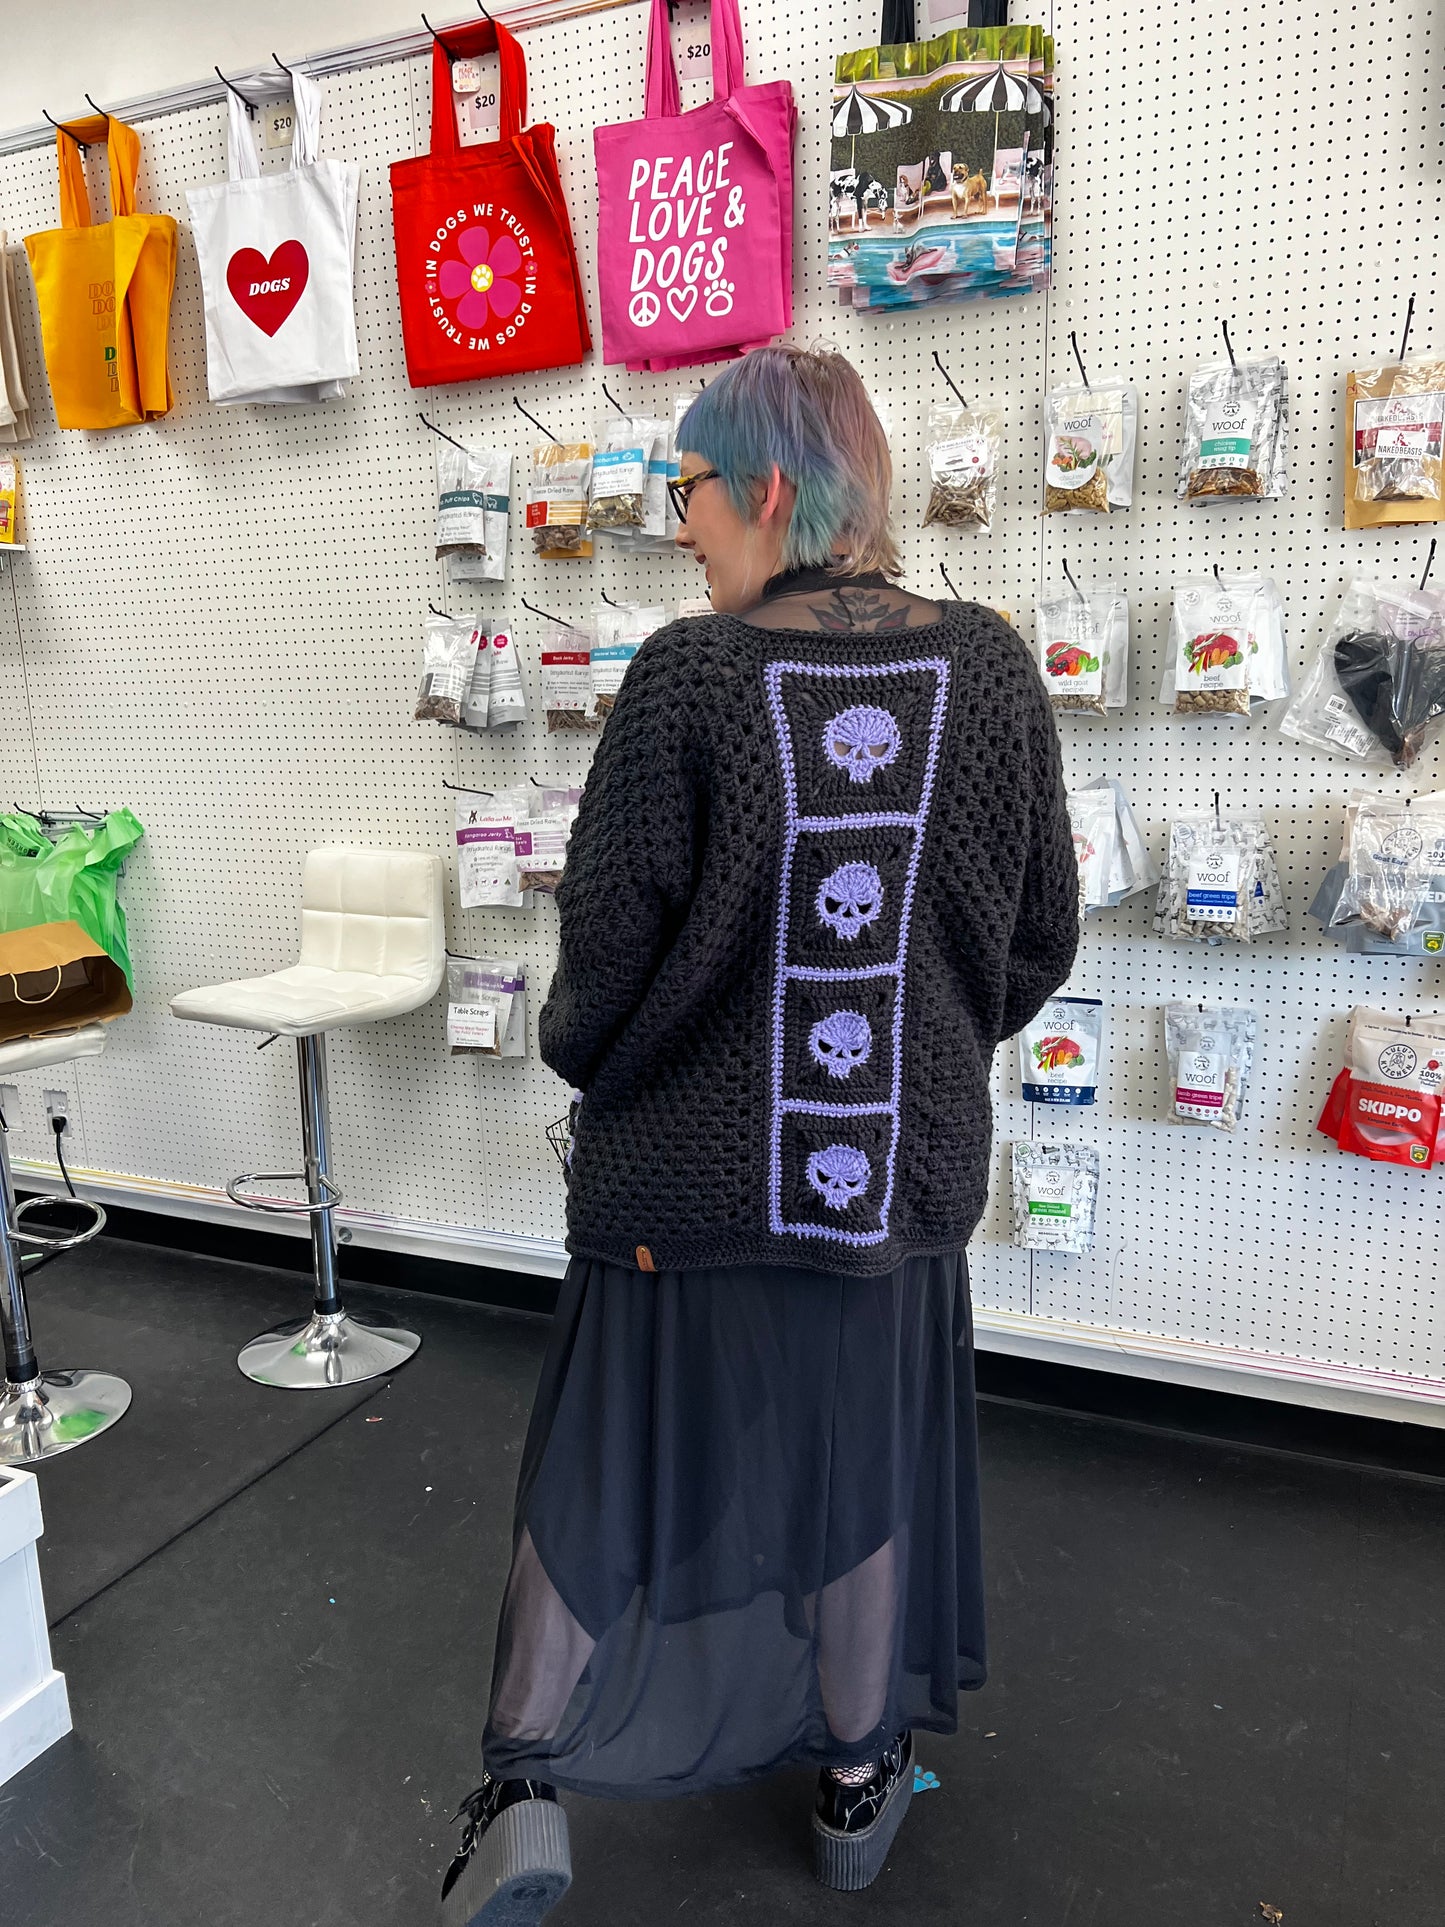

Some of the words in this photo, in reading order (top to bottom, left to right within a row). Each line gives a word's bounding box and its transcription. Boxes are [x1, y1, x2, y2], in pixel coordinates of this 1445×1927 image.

[687, 44, 711, 60] $20
[475, 94, 496, 110] $20
[273, 116, 292, 131] $20
[628, 141, 734, 201] PEACE
[473, 203, 494, 216] WE
[628, 191, 717, 243] LOVE
[723, 185, 747, 229] &
[429, 210, 467, 253] DOGS
[500, 208, 534, 257] TRUST
[425, 260, 437, 278] IN
[630, 236, 728, 292] DOGS
[88, 280, 114, 299] DO
[249, 277, 291, 297] DOGS
[525, 276, 537, 295] IN
[92, 297, 116, 315] DO
[429, 297, 462, 345] TRUST
[495, 302, 532, 345] DOGS
[468, 337, 491, 351] WE
[1064, 414, 1093, 431] woof
[1212, 418, 1247, 431] woof
[1210, 612, 1242, 623] woof
[1073, 679, 1089, 687] goat
[1200, 681, 1224, 689] recipe
[1372, 853, 1391, 863] Goat
[1391, 857, 1409, 866] Ears
[1196, 870, 1231, 883] woof
[454, 1006, 469, 1015] Table
[470, 1007, 489, 1017] Scraps
[1043, 1019, 1076, 1031] woof
[1385, 1046, 1414, 1060] LULU'S
[1380, 1060, 1413, 1077] KITCHEN
[1420, 1070, 1442, 1080] 100%
[1185, 1073, 1218, 1085] woof
[1177, 1089, 1192, 1097] lamb
[1208, 1094, 1223, 1102] tripe
[1358, 1097, 1422, 1123] SKIPPO
[1037, 1186, 1066, 1196] woof
